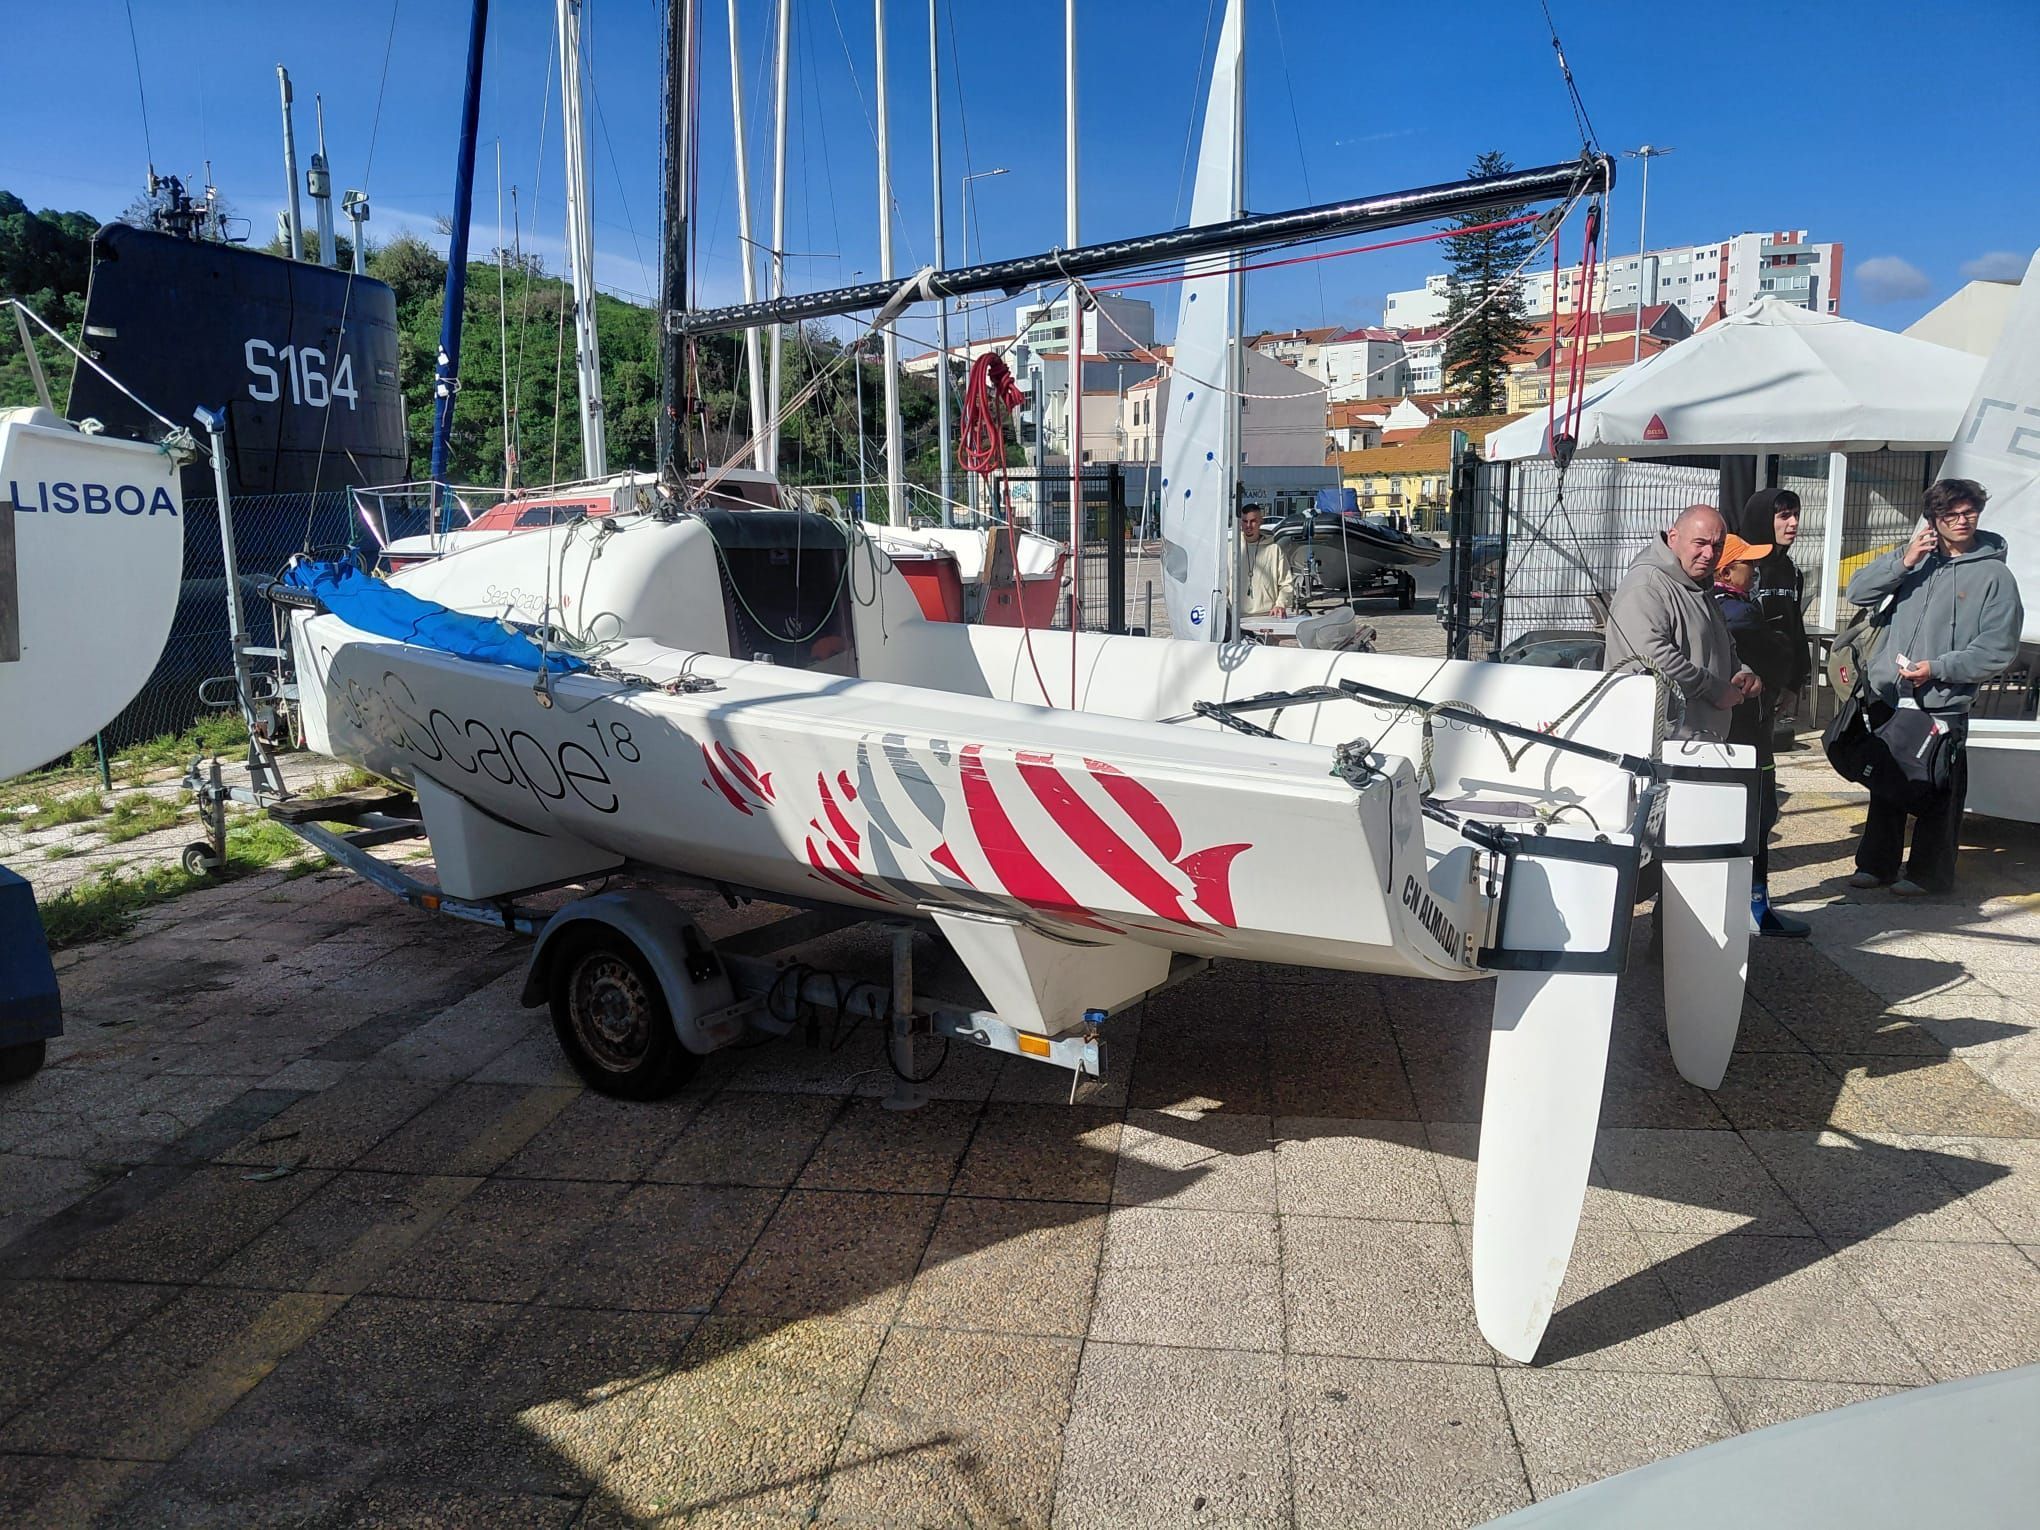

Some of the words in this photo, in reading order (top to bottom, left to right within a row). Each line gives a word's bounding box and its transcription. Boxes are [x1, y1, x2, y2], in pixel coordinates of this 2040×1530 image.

[244, 338, 359, 411] S164
[10, 481, 178, 516] LISBOA
[587, 718, 641, 763] 18
[1402, 874, 1423, 915] CN
[1418, 902, 1462, 963] ALMADA
